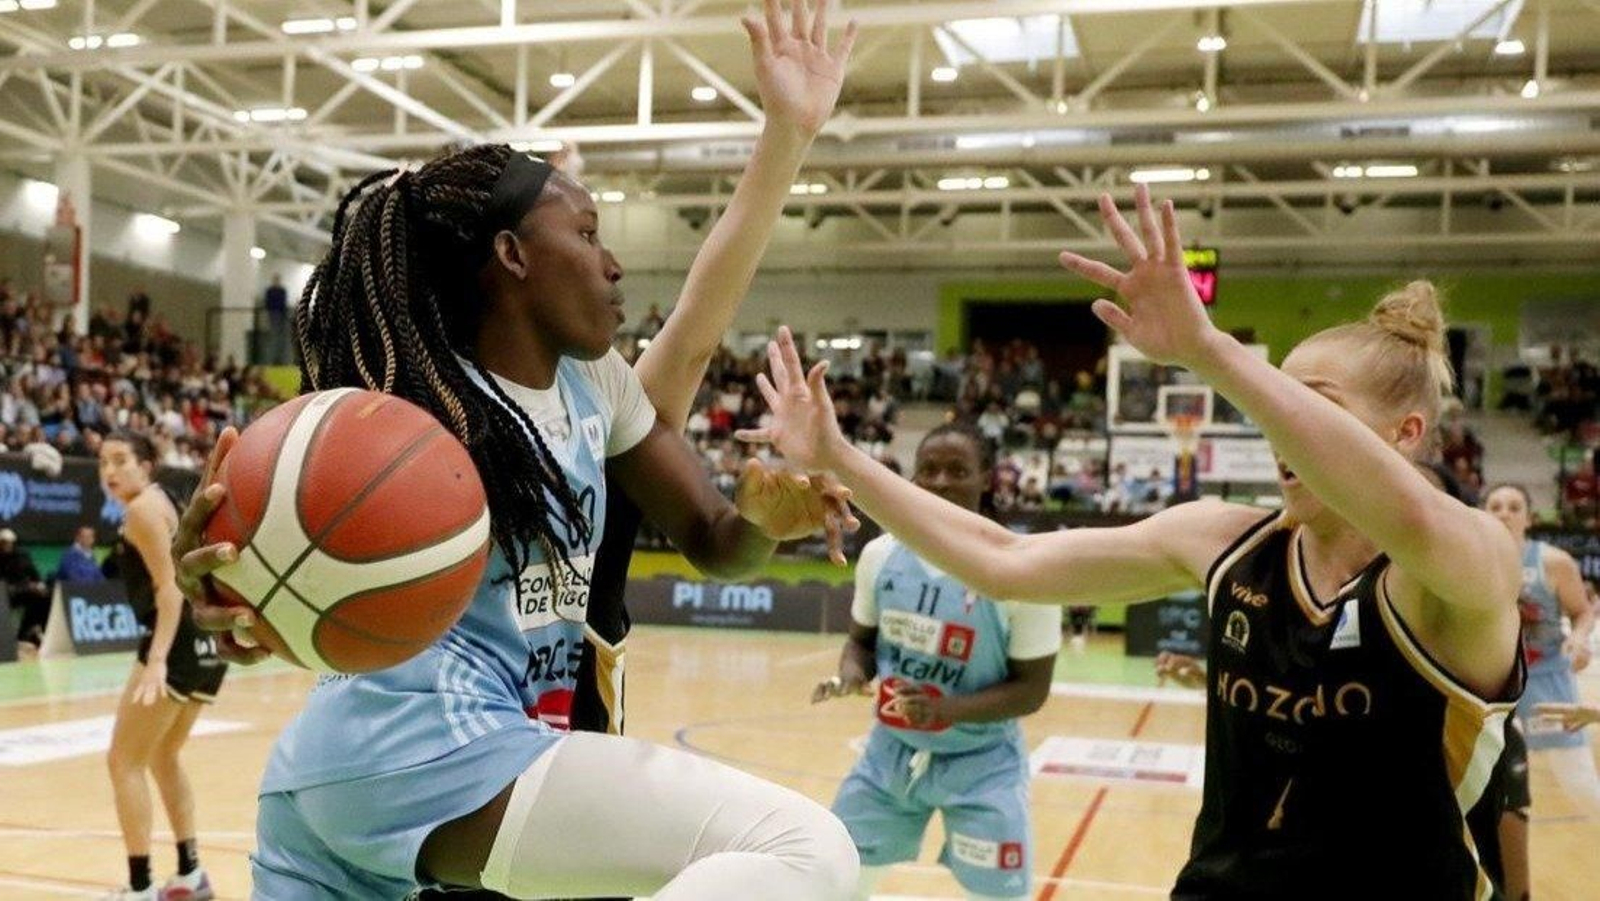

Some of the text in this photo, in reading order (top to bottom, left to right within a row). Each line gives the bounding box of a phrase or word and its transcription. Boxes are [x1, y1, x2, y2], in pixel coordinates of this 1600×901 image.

[524, 591, 588, 615] DE IGO
[916, 582, 941, 616] 11
